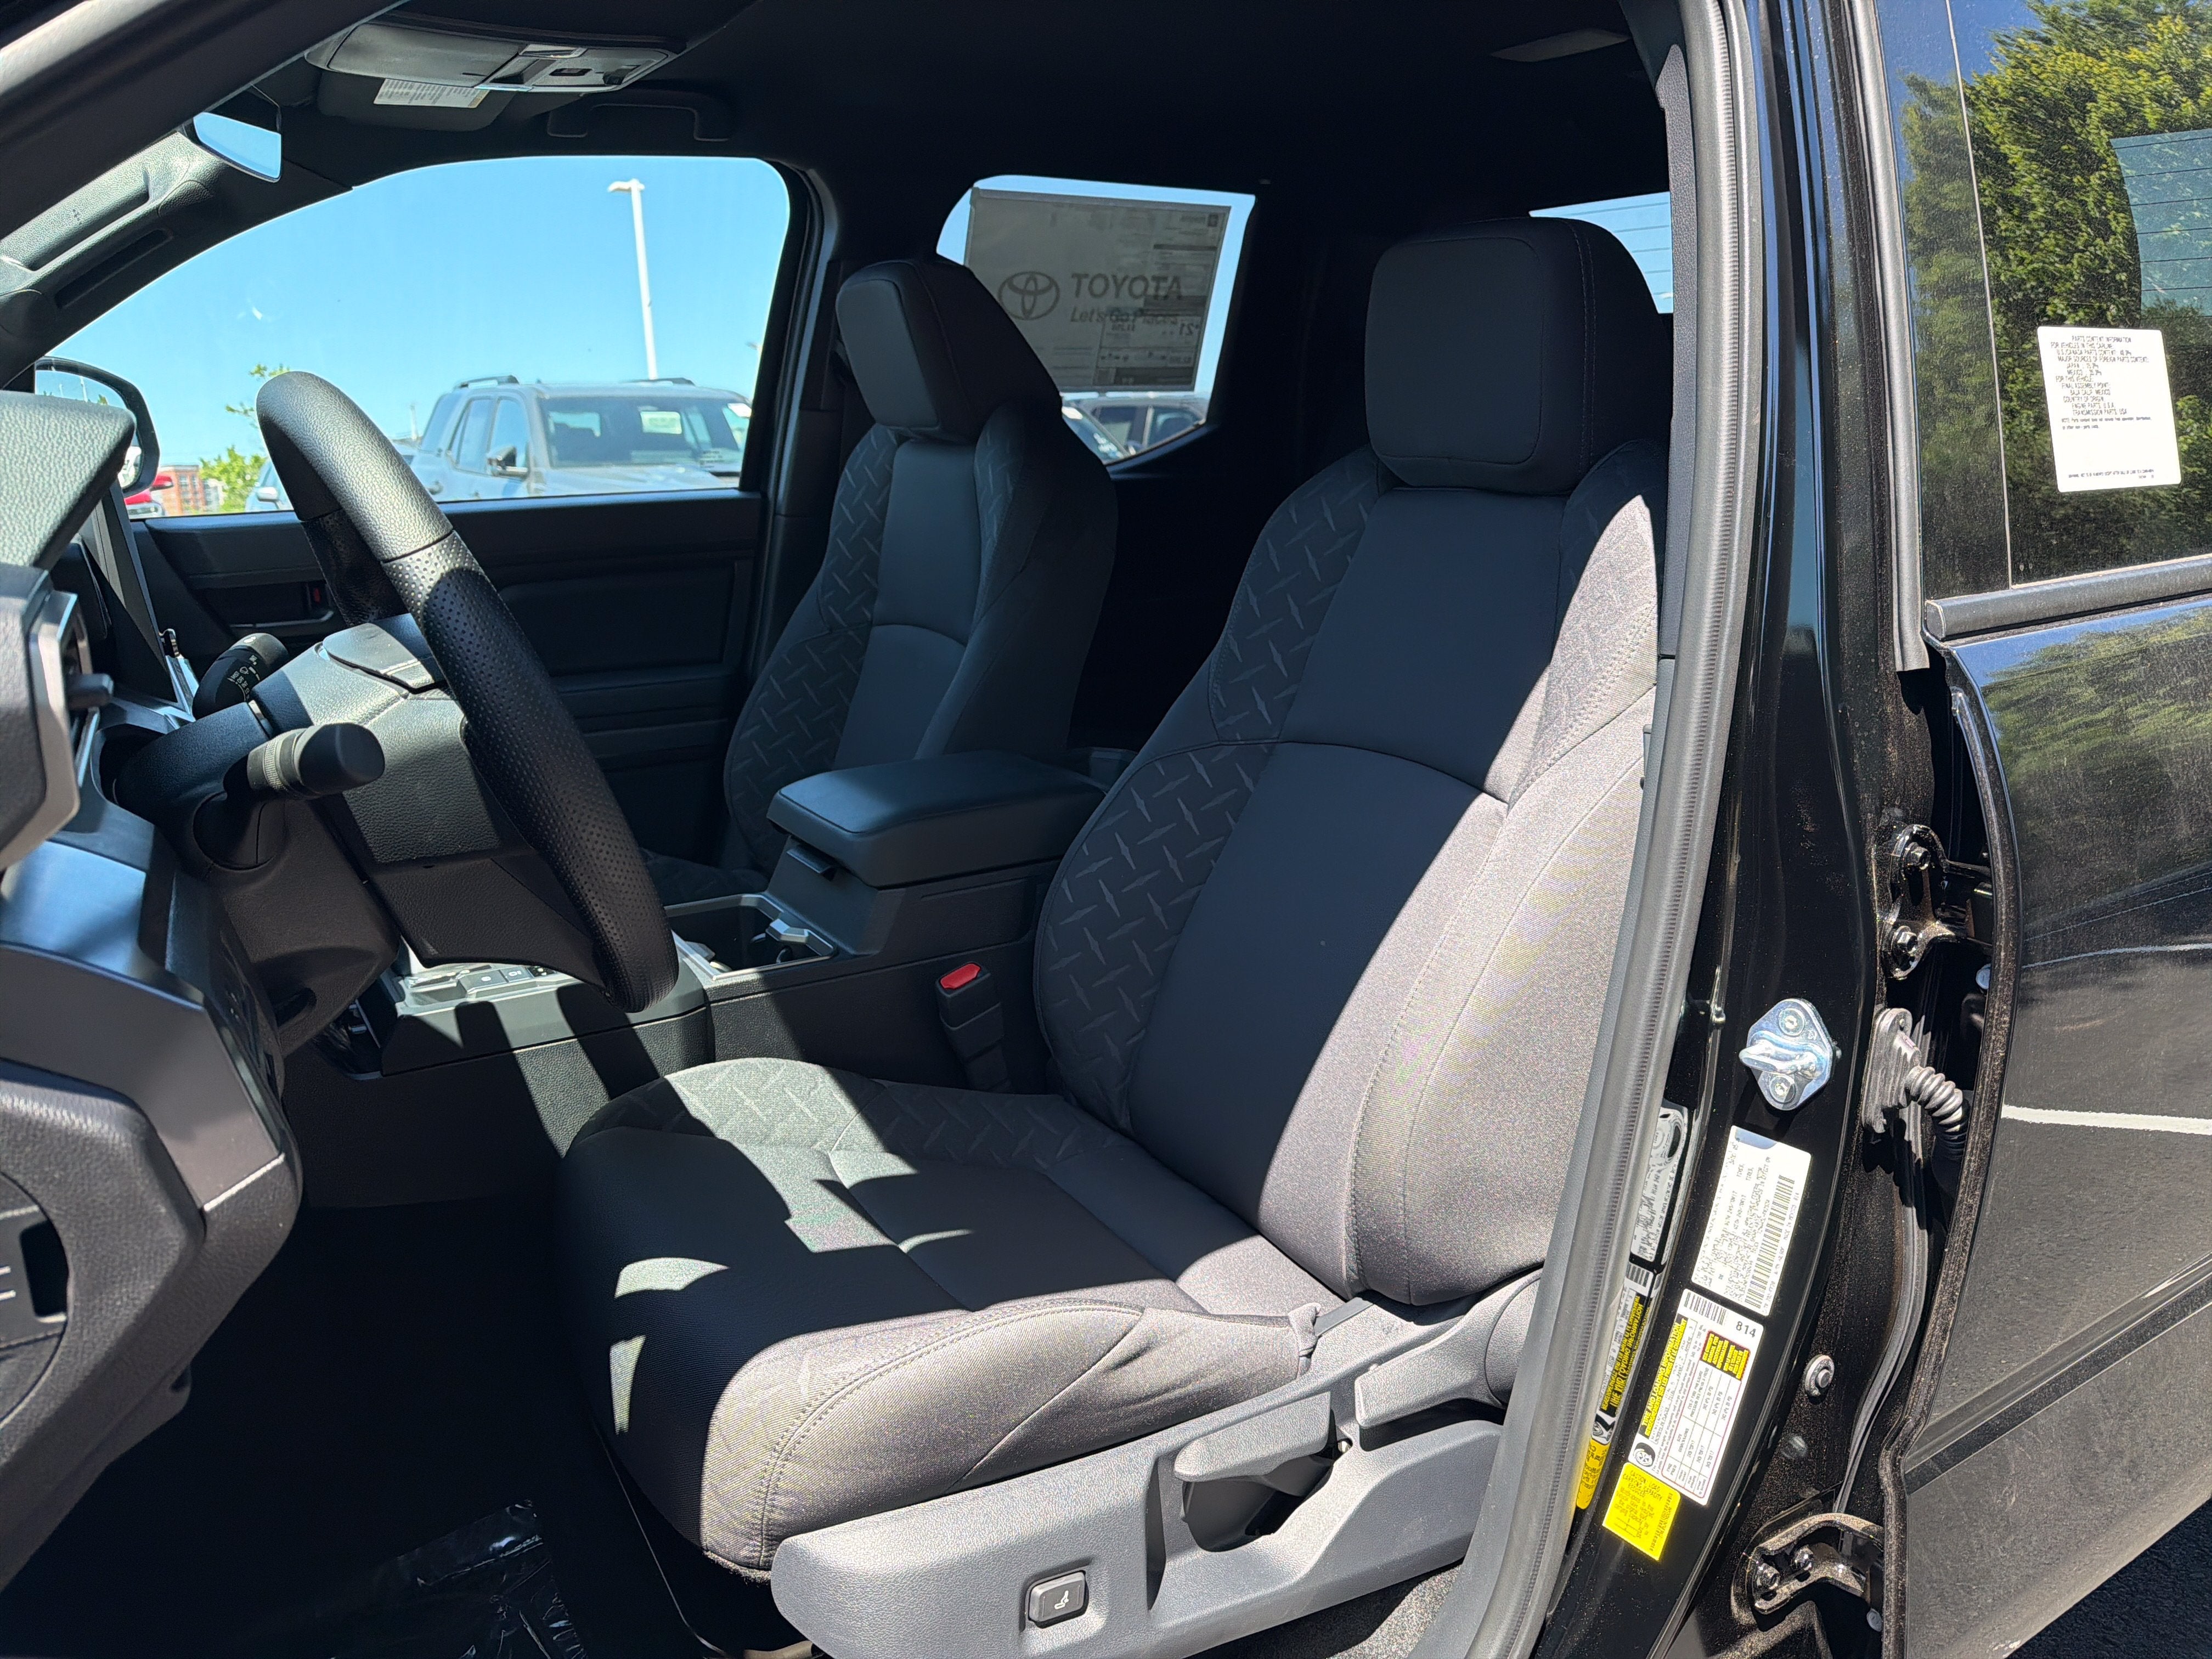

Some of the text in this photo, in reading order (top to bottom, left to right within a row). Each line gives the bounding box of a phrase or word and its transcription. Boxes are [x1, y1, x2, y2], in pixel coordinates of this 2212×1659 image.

[1071, 273, 1182, 301] TOYOTA
[1735, 1319, 1757, 1339] 814
[1661, 1322, 1681, 1368] INFORMATION
[1651, 1365, 1666, 1397] LOADING
[1646, 1395, 1656, 1410] AND
[1641, 1409, 1652, 1427] TIRE
